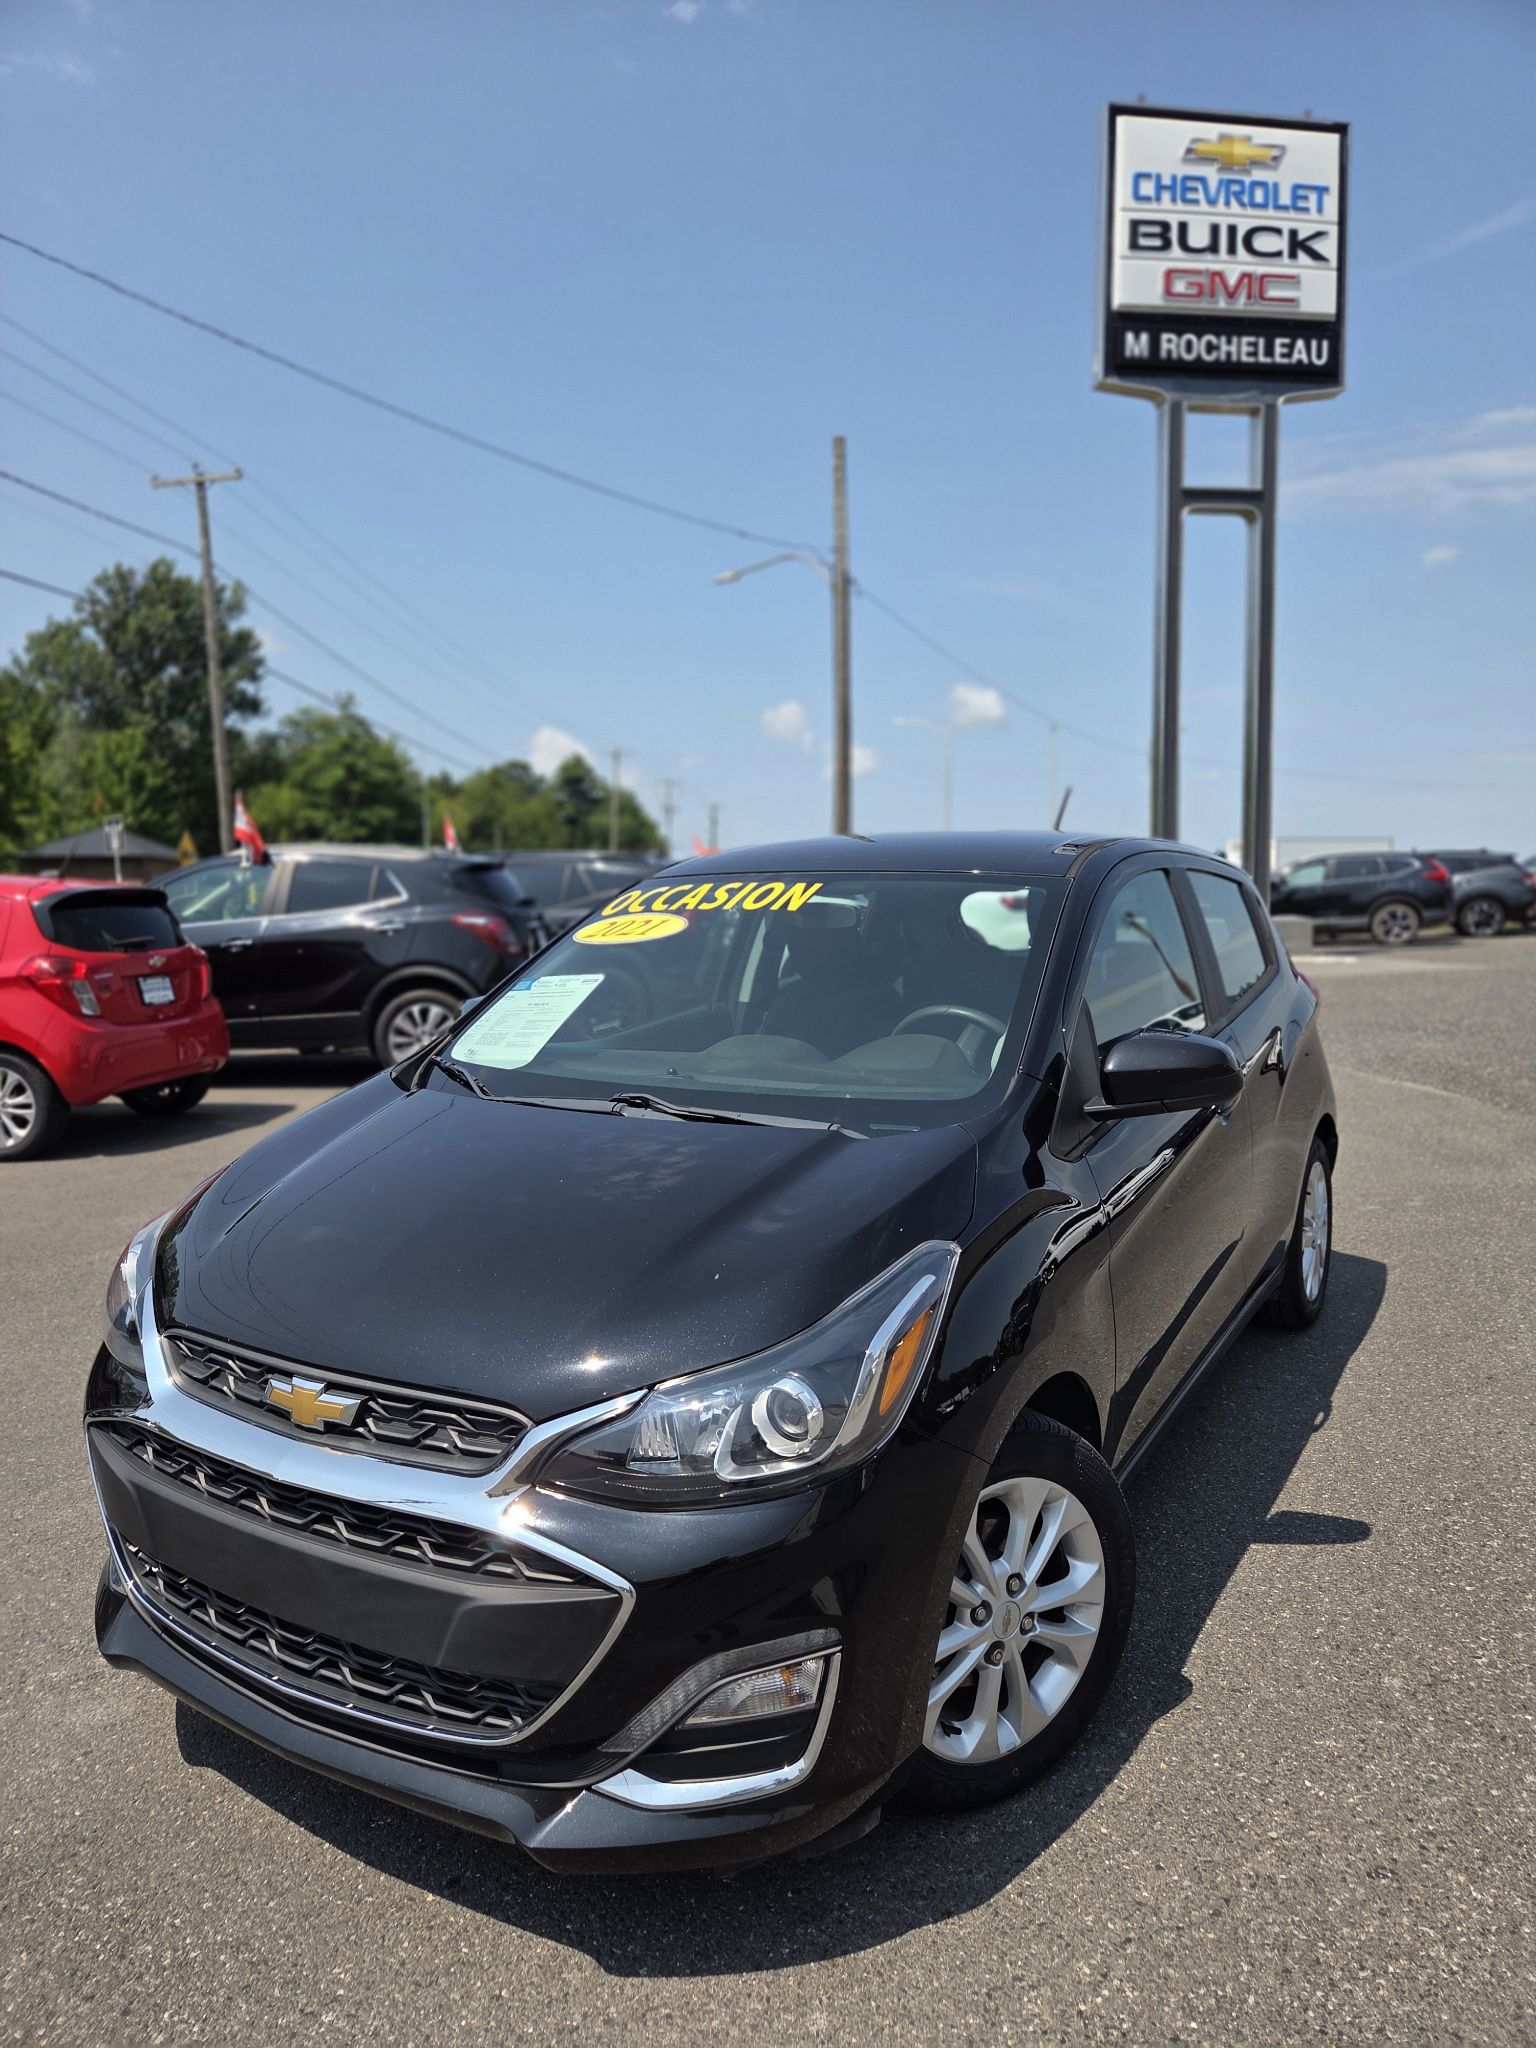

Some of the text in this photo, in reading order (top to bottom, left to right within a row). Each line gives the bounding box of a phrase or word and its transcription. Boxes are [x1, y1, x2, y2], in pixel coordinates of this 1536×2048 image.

[1131, 171, 1330, 214] CHEVROLET
[1128, 218, 1331, 263] BUICK
[1163, 267, 1299, 305] GMC
[1124, 331, 1329, 366] M ROCHELEAU
[601, 881, 824, 916] OCCASION
[582, 918, 671, 939] 2021
